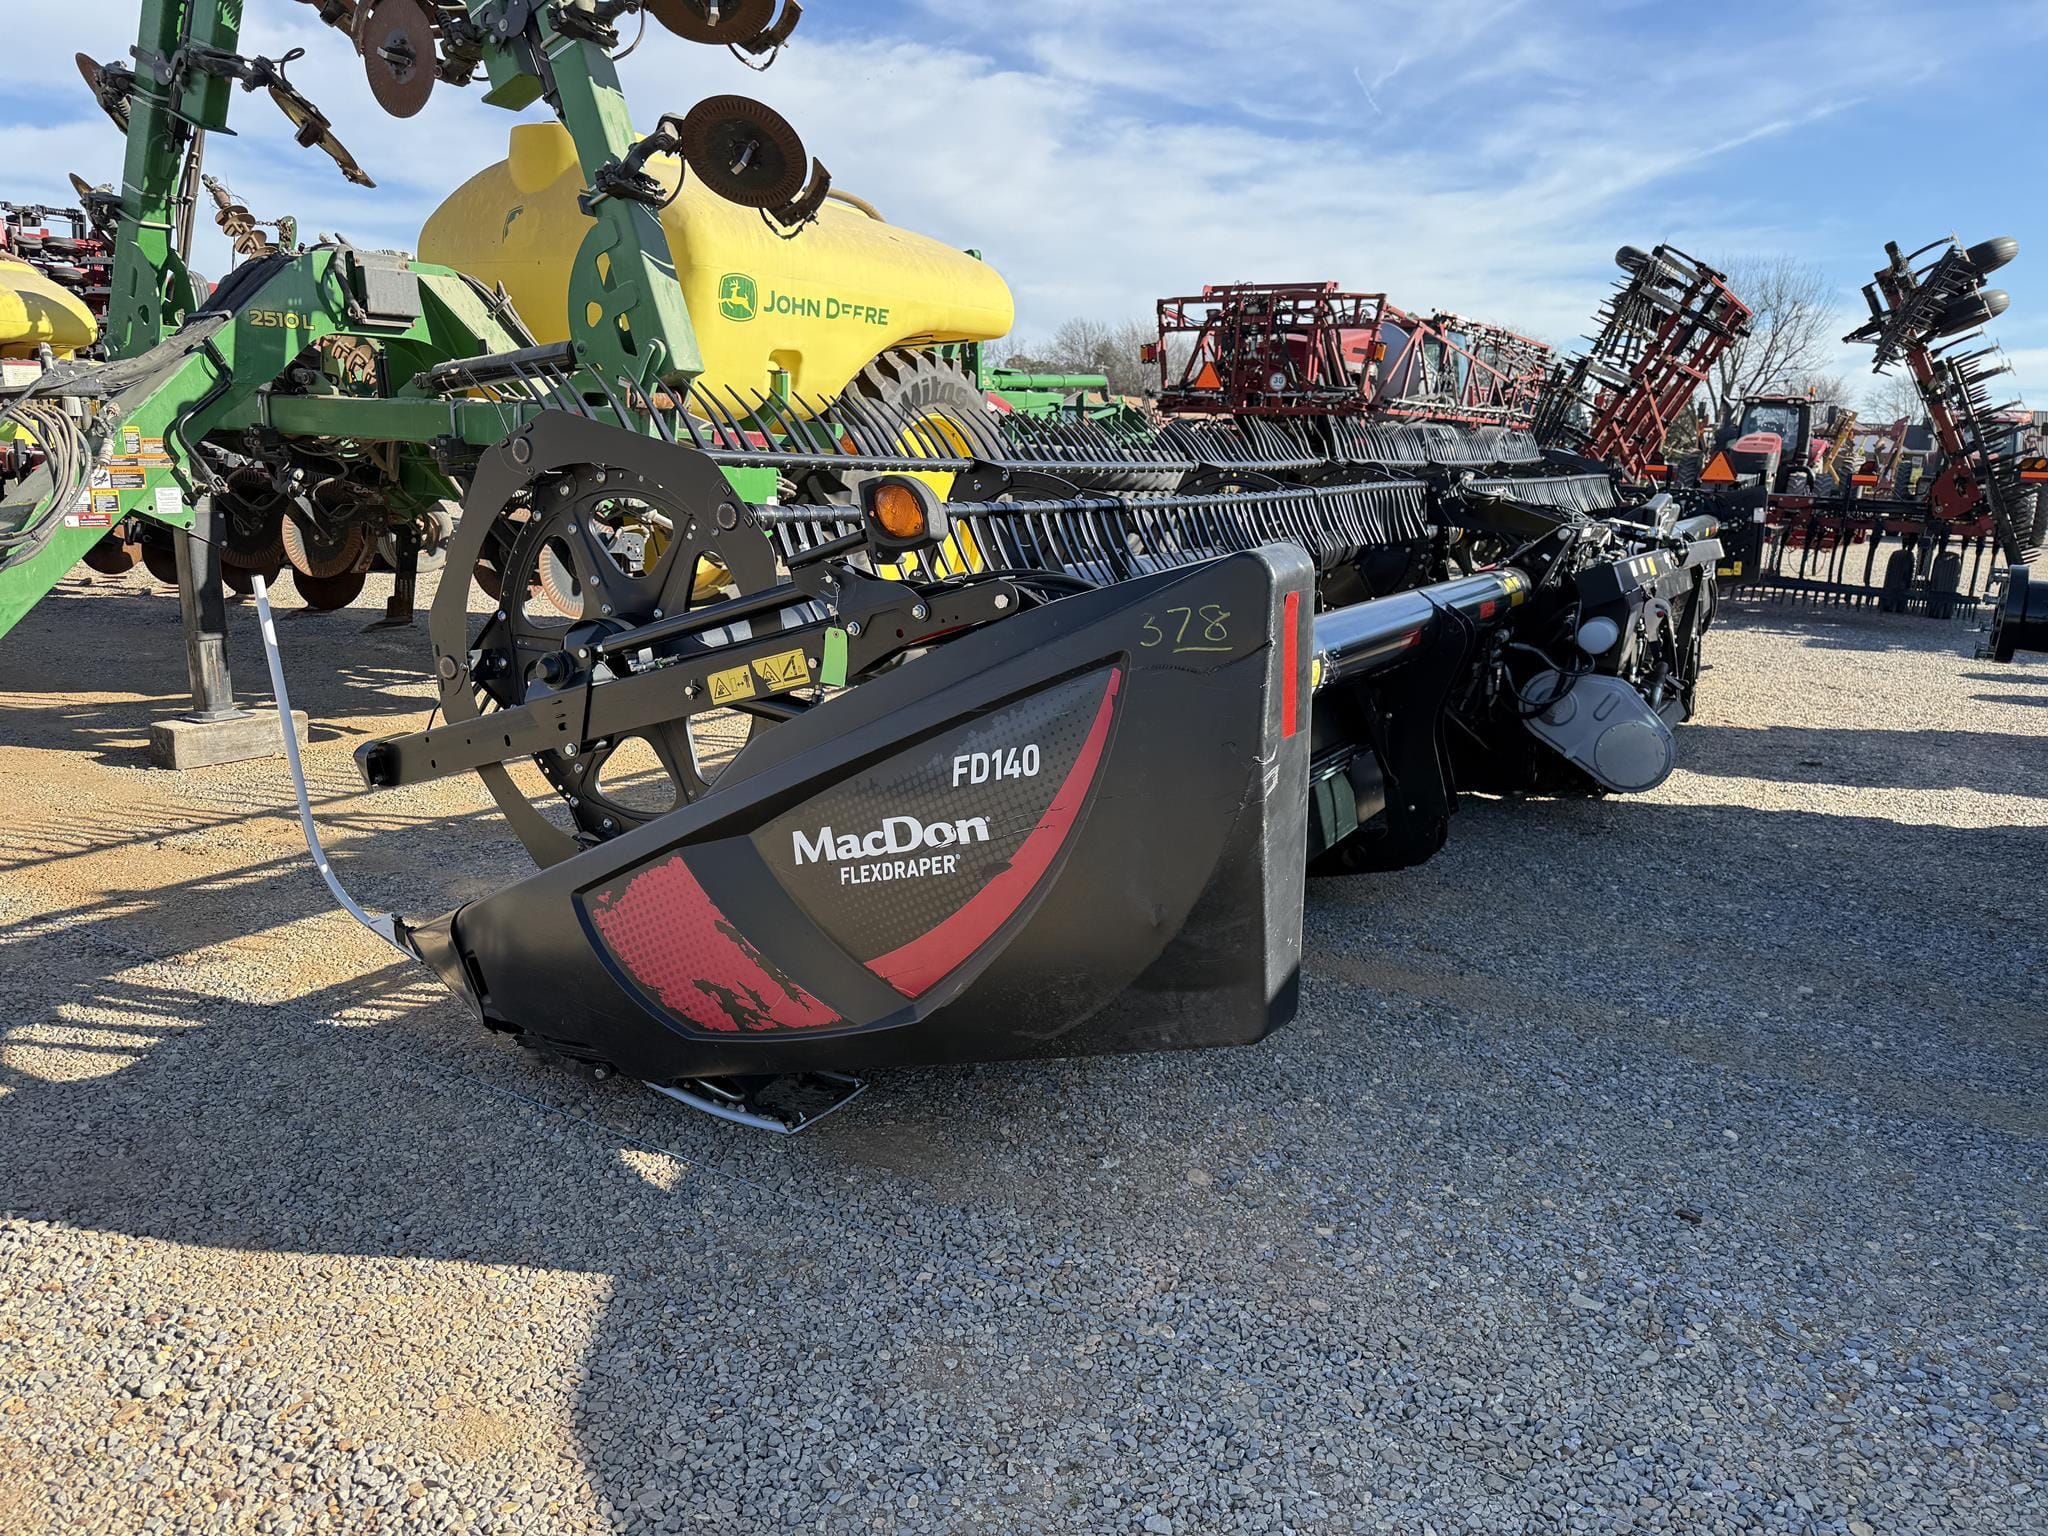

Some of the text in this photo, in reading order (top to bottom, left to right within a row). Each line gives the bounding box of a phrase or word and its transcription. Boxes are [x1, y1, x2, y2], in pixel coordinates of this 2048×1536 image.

[763, 290, 821, 318] JOHN
[900, 375, 970, 419] Mitas
[1140, 604, 1231, 648] 378
[952, 743, 1041, 788] FD140
[792, 815, 990, 866] MacDon
[840, 855, 957, 886] FLEXDRAPER
